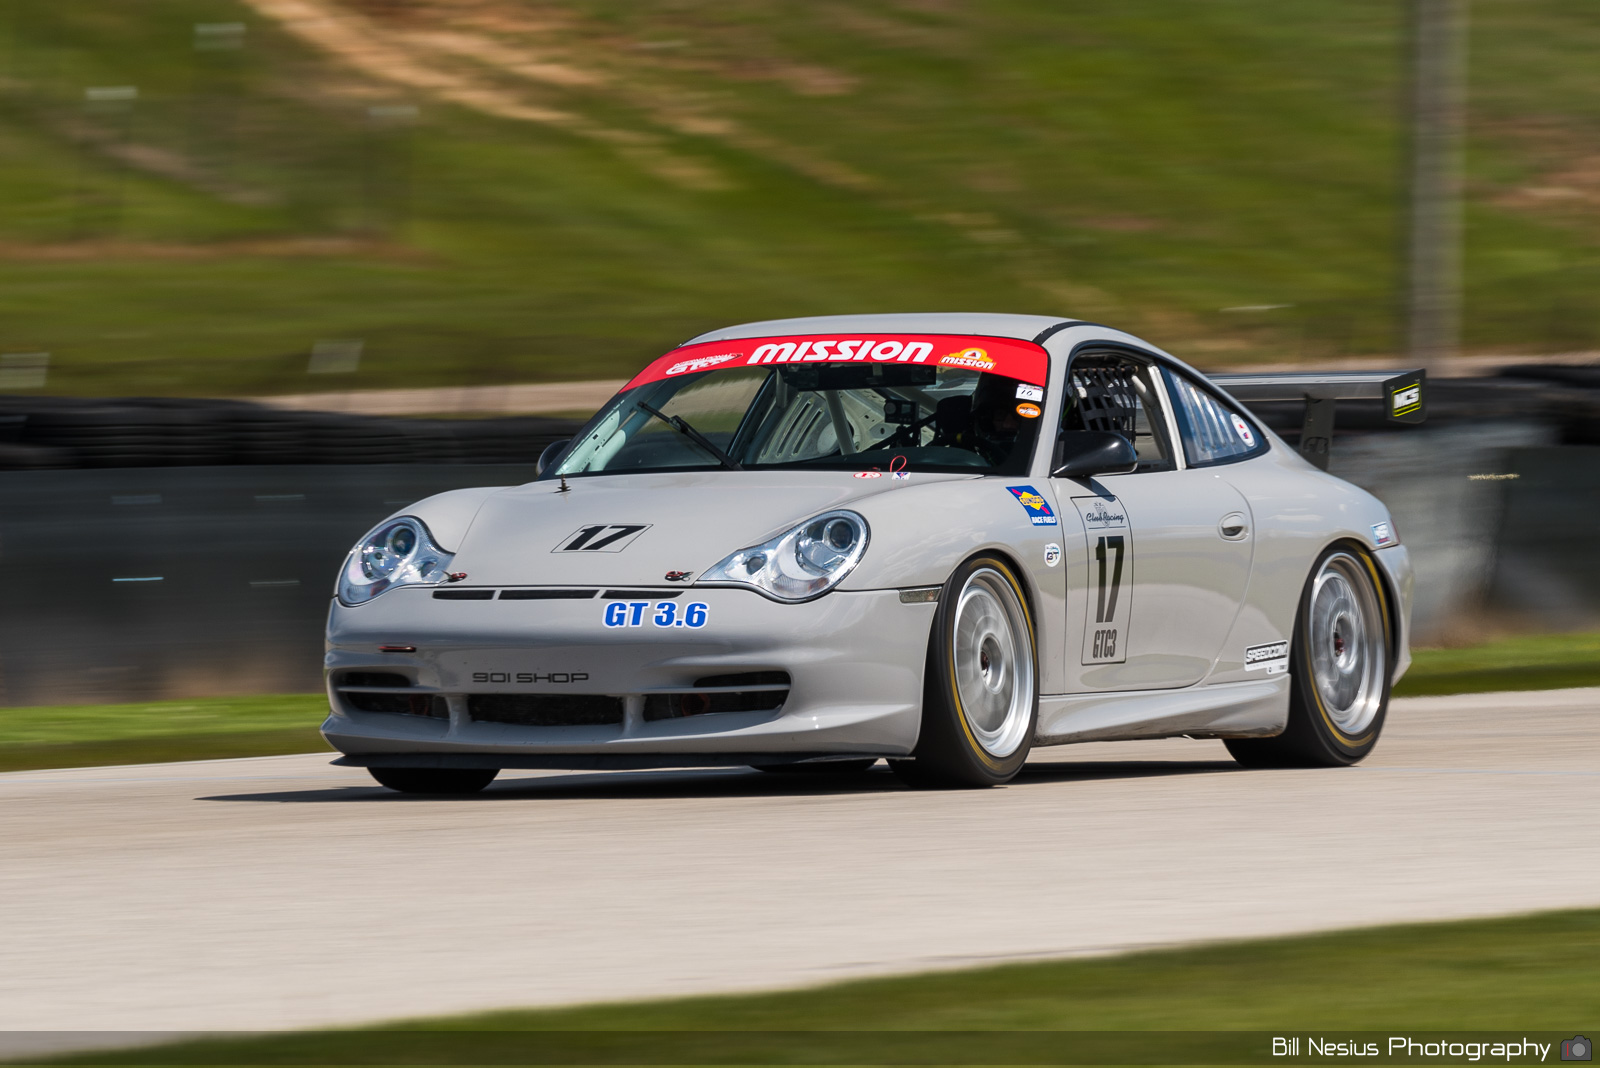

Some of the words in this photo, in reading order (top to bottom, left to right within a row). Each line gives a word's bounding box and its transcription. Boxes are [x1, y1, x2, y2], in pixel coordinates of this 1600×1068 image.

[747, 340, 934, 364] MISSION
[1031, 516, 1043, 524] RACE
[1044, 516, 1056, 524] FUELS
[1086, 512, 1103, 522] Club
[1103, 511, 1124, 523] Racing
[563, 525, 647, 551] 17
[1095, 535, 1125, 624] 17
[602, 600, 651, 629] GT
[653, 600, 710, 630] 3.6
[1092, 628, 1117, 659] GTC3
[472, 672, 511, 683] 901
[516, 672, 589, 684] SHOP
